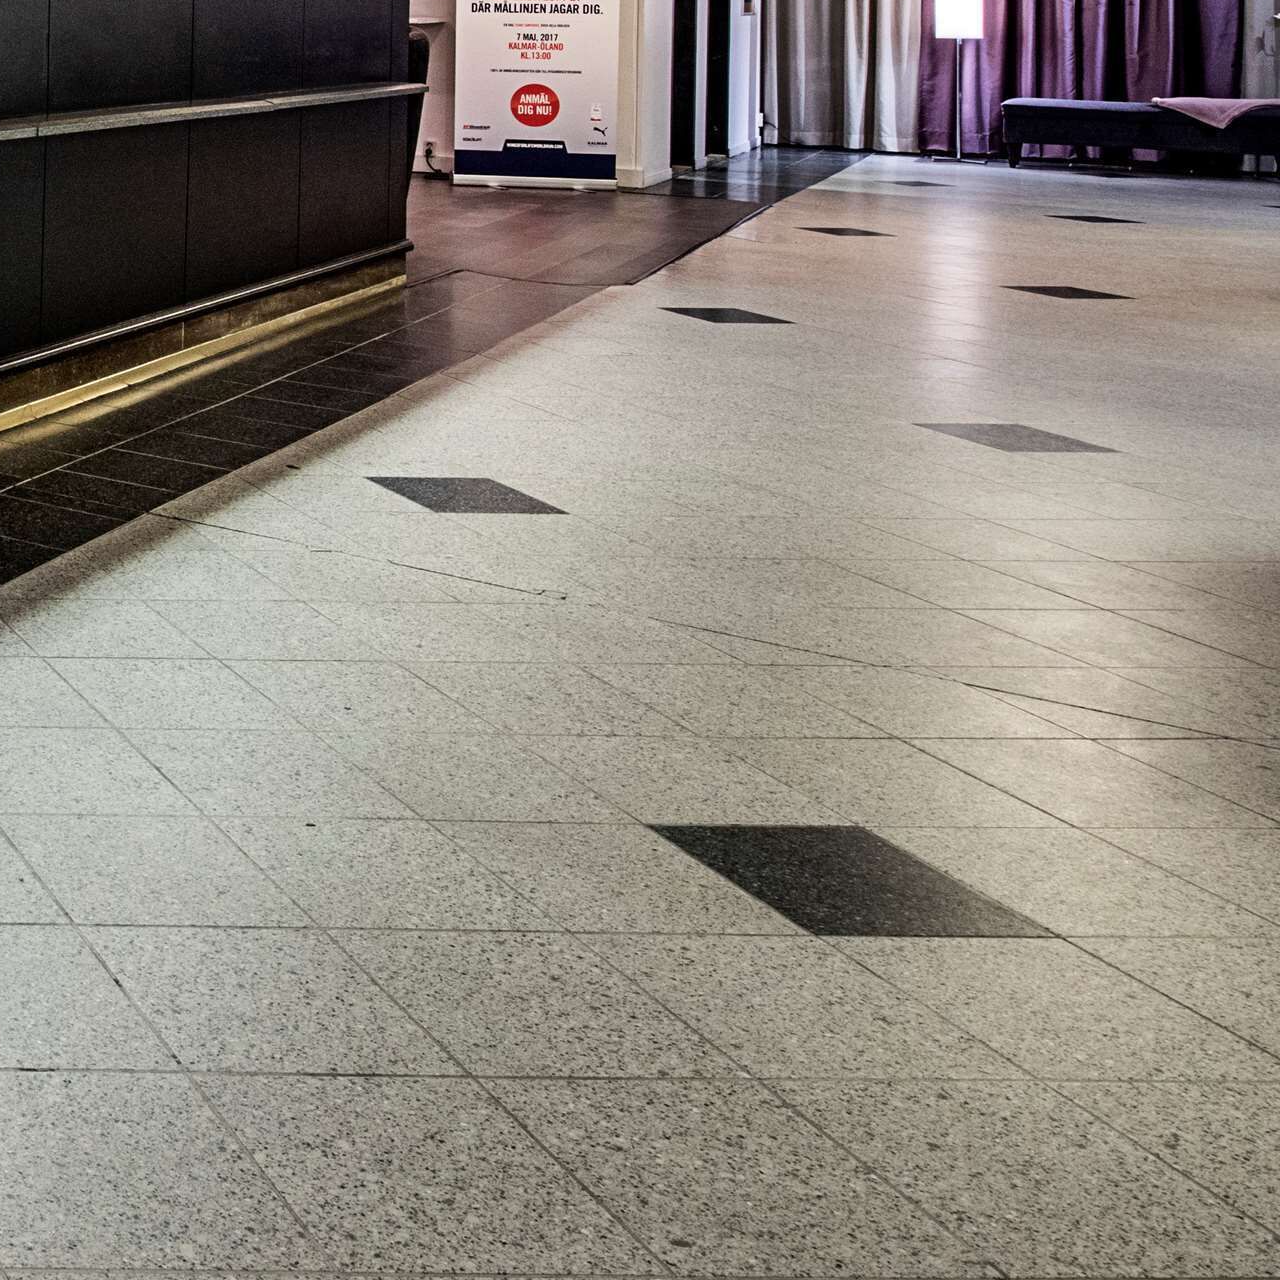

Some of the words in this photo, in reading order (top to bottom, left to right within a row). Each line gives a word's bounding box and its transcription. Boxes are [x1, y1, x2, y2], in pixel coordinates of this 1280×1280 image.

[471, 1, 491, 13] DÄR
[493, 1, 547, 14] MÅLLINJEN
[549, 4, 580, 14] JAGAR
[582, 4, 604, 15] DIG.
[516, 32, 521, 41] 7
[540, 33, 559, 42] 2017
[519, 92, 551, 104] ANMÄL
[517, 105, 534, 115] DIG
[536, 105, 553, 116] NU!
